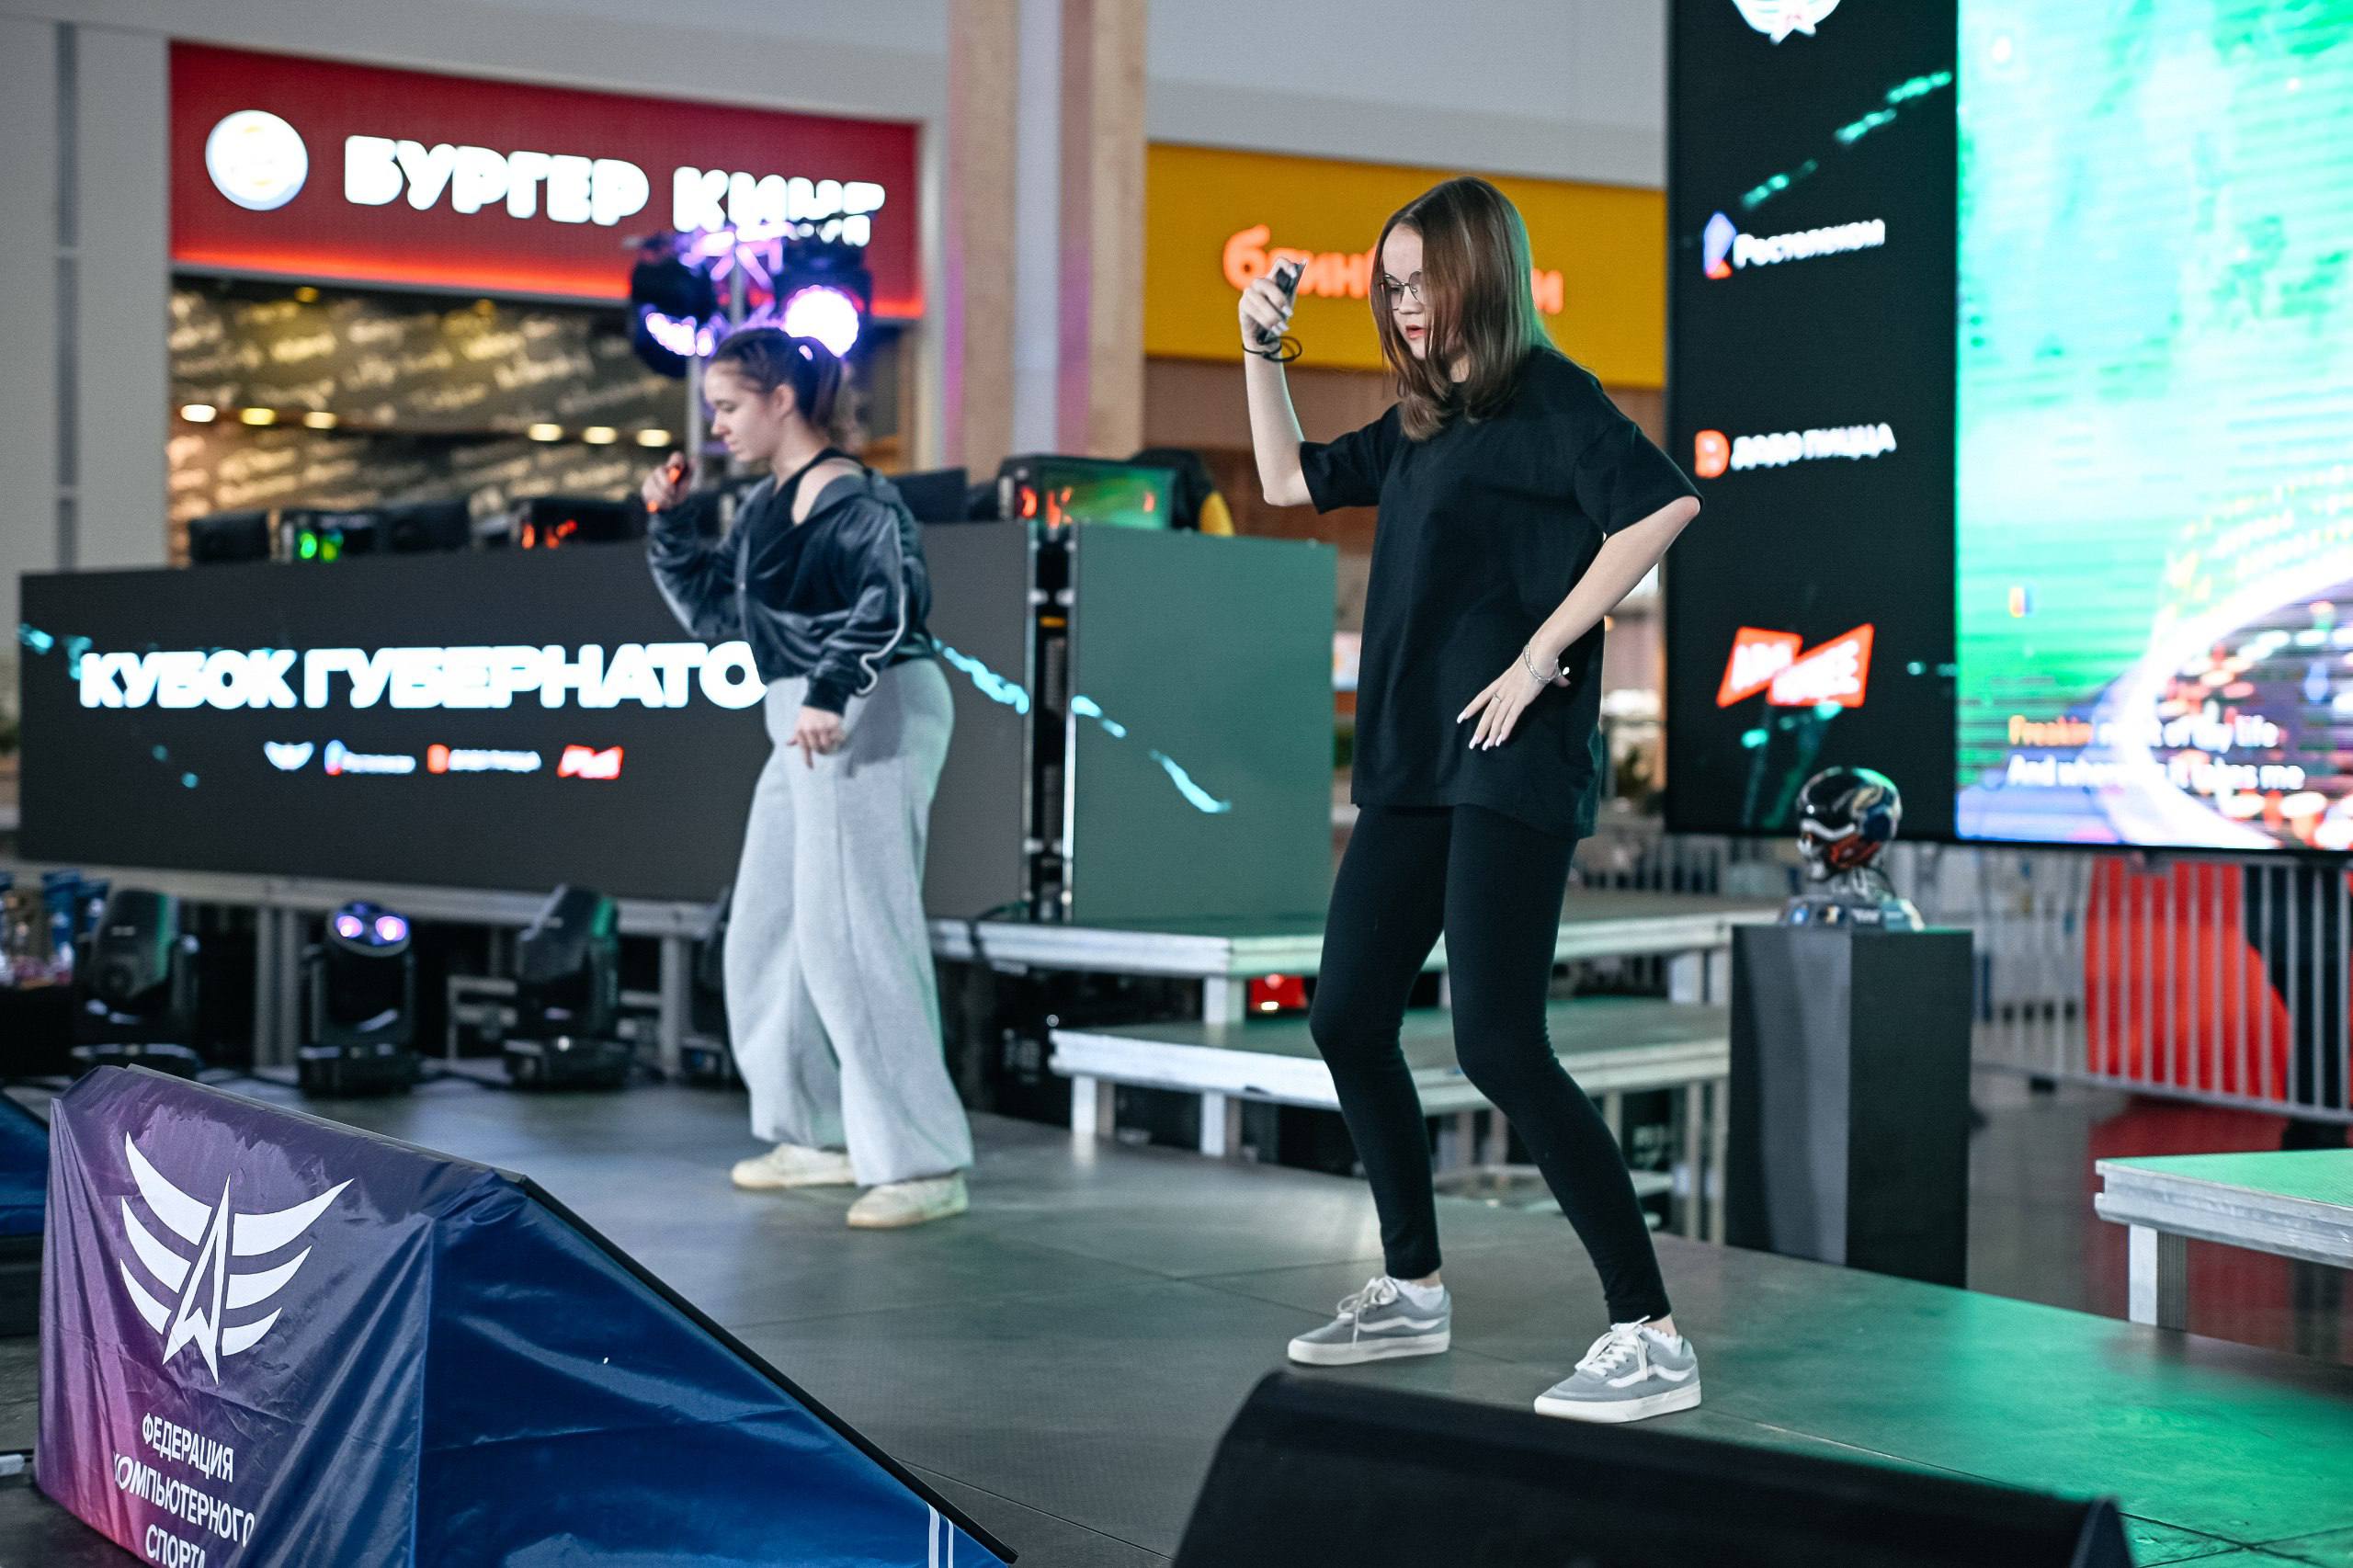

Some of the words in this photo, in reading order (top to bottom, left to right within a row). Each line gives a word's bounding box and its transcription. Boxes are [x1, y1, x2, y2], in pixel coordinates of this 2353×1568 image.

[345, 135, 650, 226] БУРГЕР
[79, 649, 297, 710] КУБОК
[142, 1412, 234, 1483] ФЕДЕРАЦИЯ
